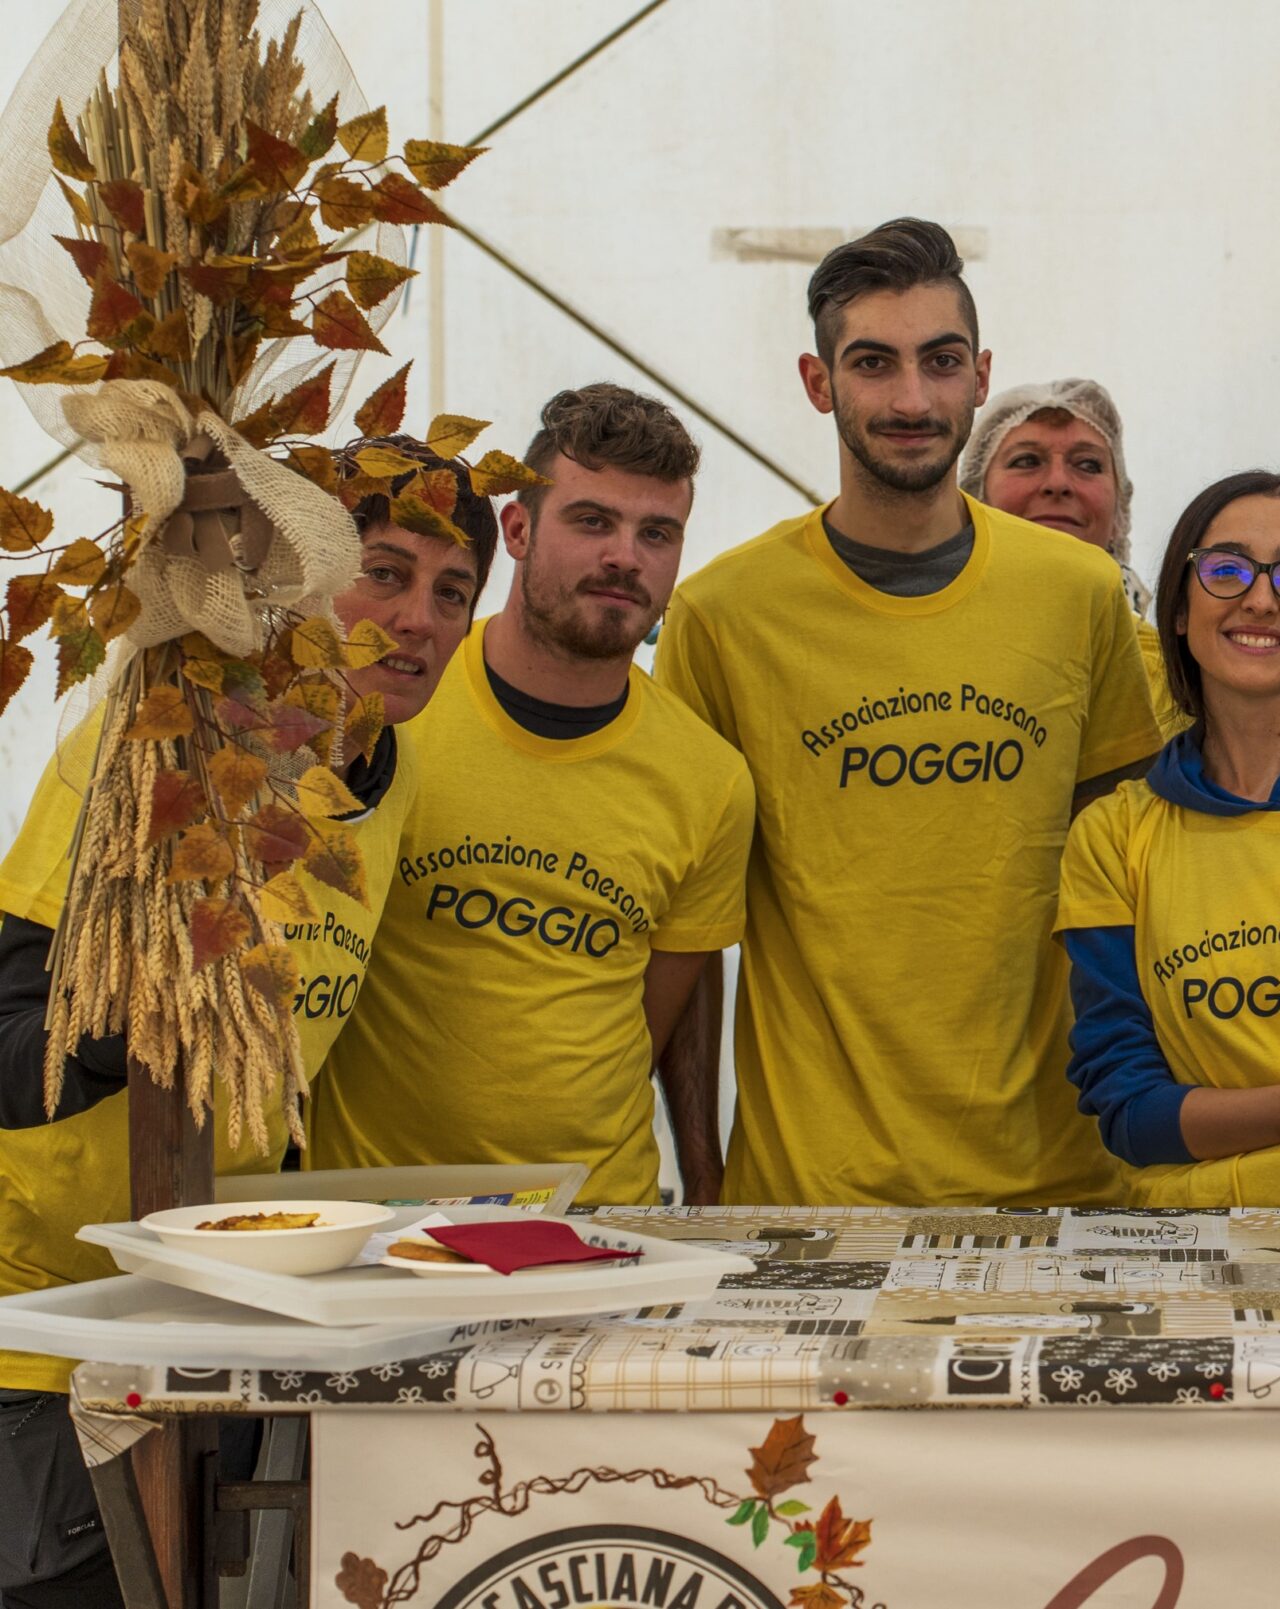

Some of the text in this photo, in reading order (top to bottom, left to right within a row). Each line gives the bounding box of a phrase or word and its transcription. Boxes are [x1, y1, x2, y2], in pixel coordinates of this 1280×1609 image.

[801, 683, 1047, 757] Associazione Paesana
[839, 739, 1024, 788] POGGIO
[400, 835, 559, 887] Associazione
[426, 884, 621, 958] POGGIO
